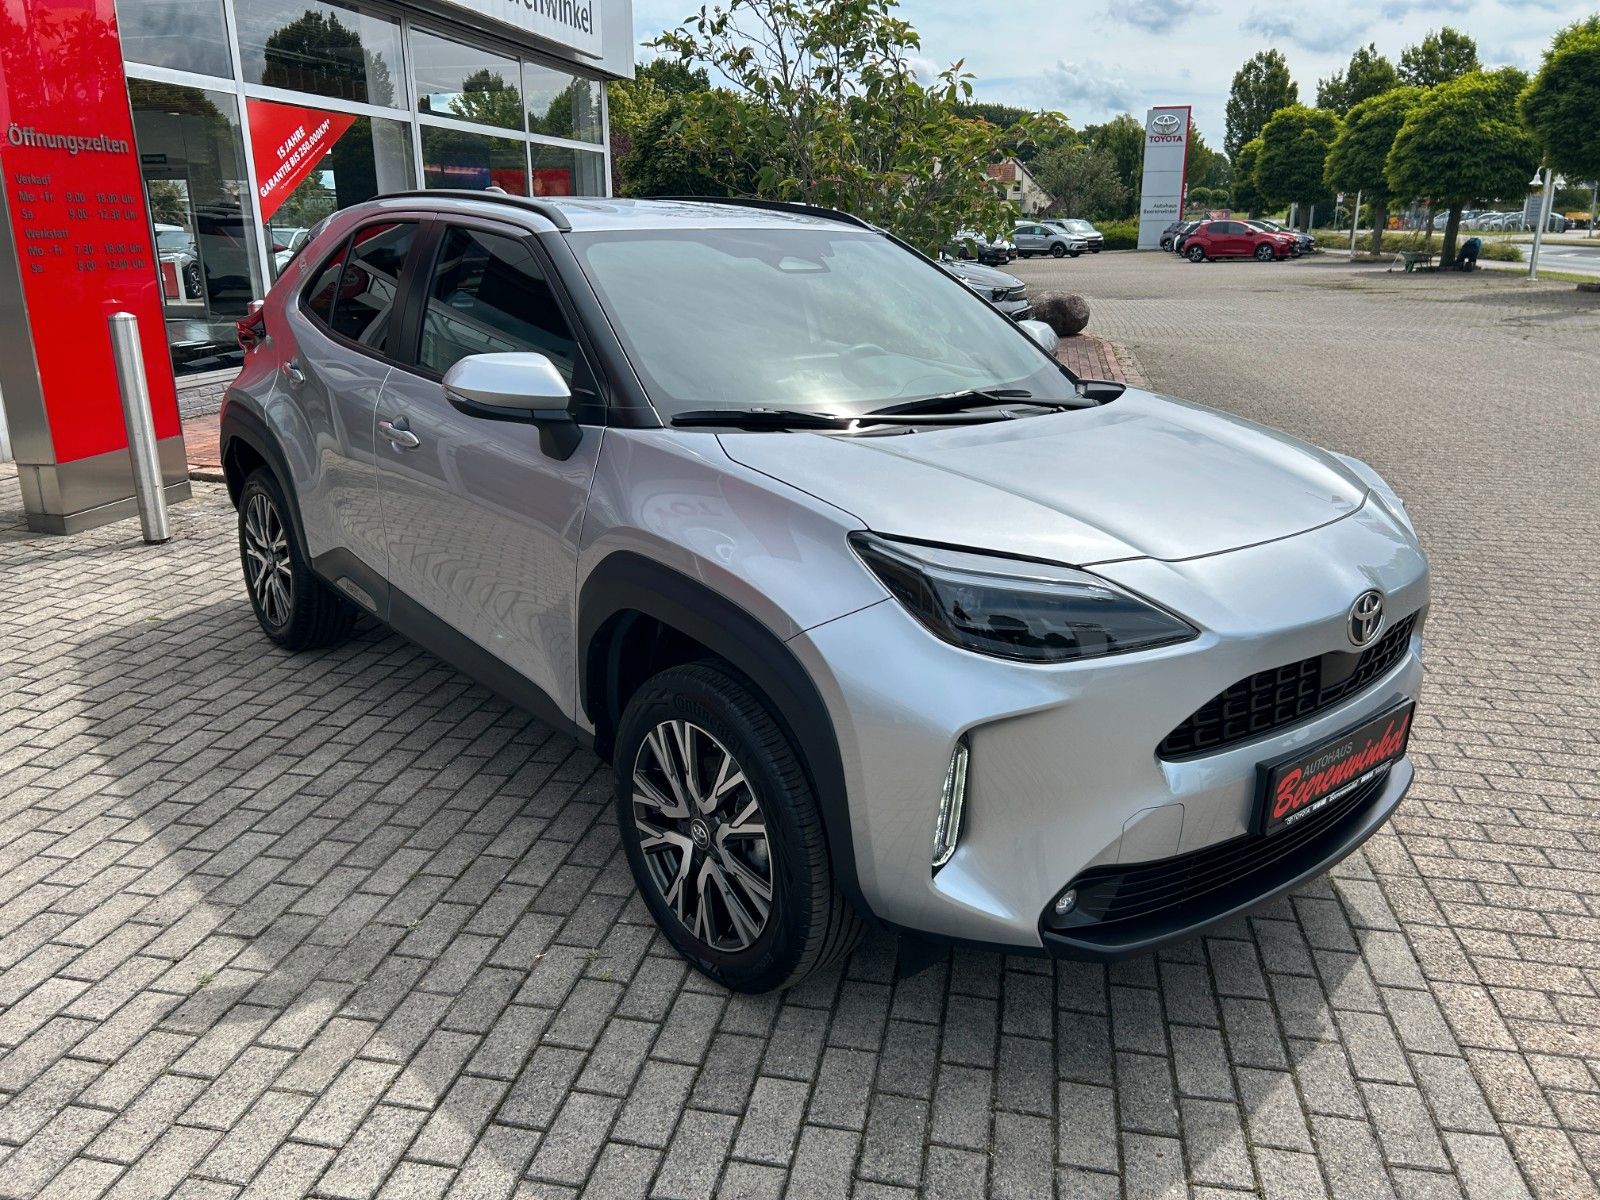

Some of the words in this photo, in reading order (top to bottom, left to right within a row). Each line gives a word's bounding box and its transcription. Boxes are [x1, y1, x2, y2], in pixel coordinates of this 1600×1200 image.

[8, 122, 129, 155] Öffnungszeiten
[276, 147, 286, 160] 15
[285, 125, 307, 154] JAHRE
[1149, 135, 1183, 143] TOYOTA
[260, 163, 291, 197] GARANTIE
[289, 151, 302, 169] BIS
[1303, 742, 1353, 778] AUTOHAUS
